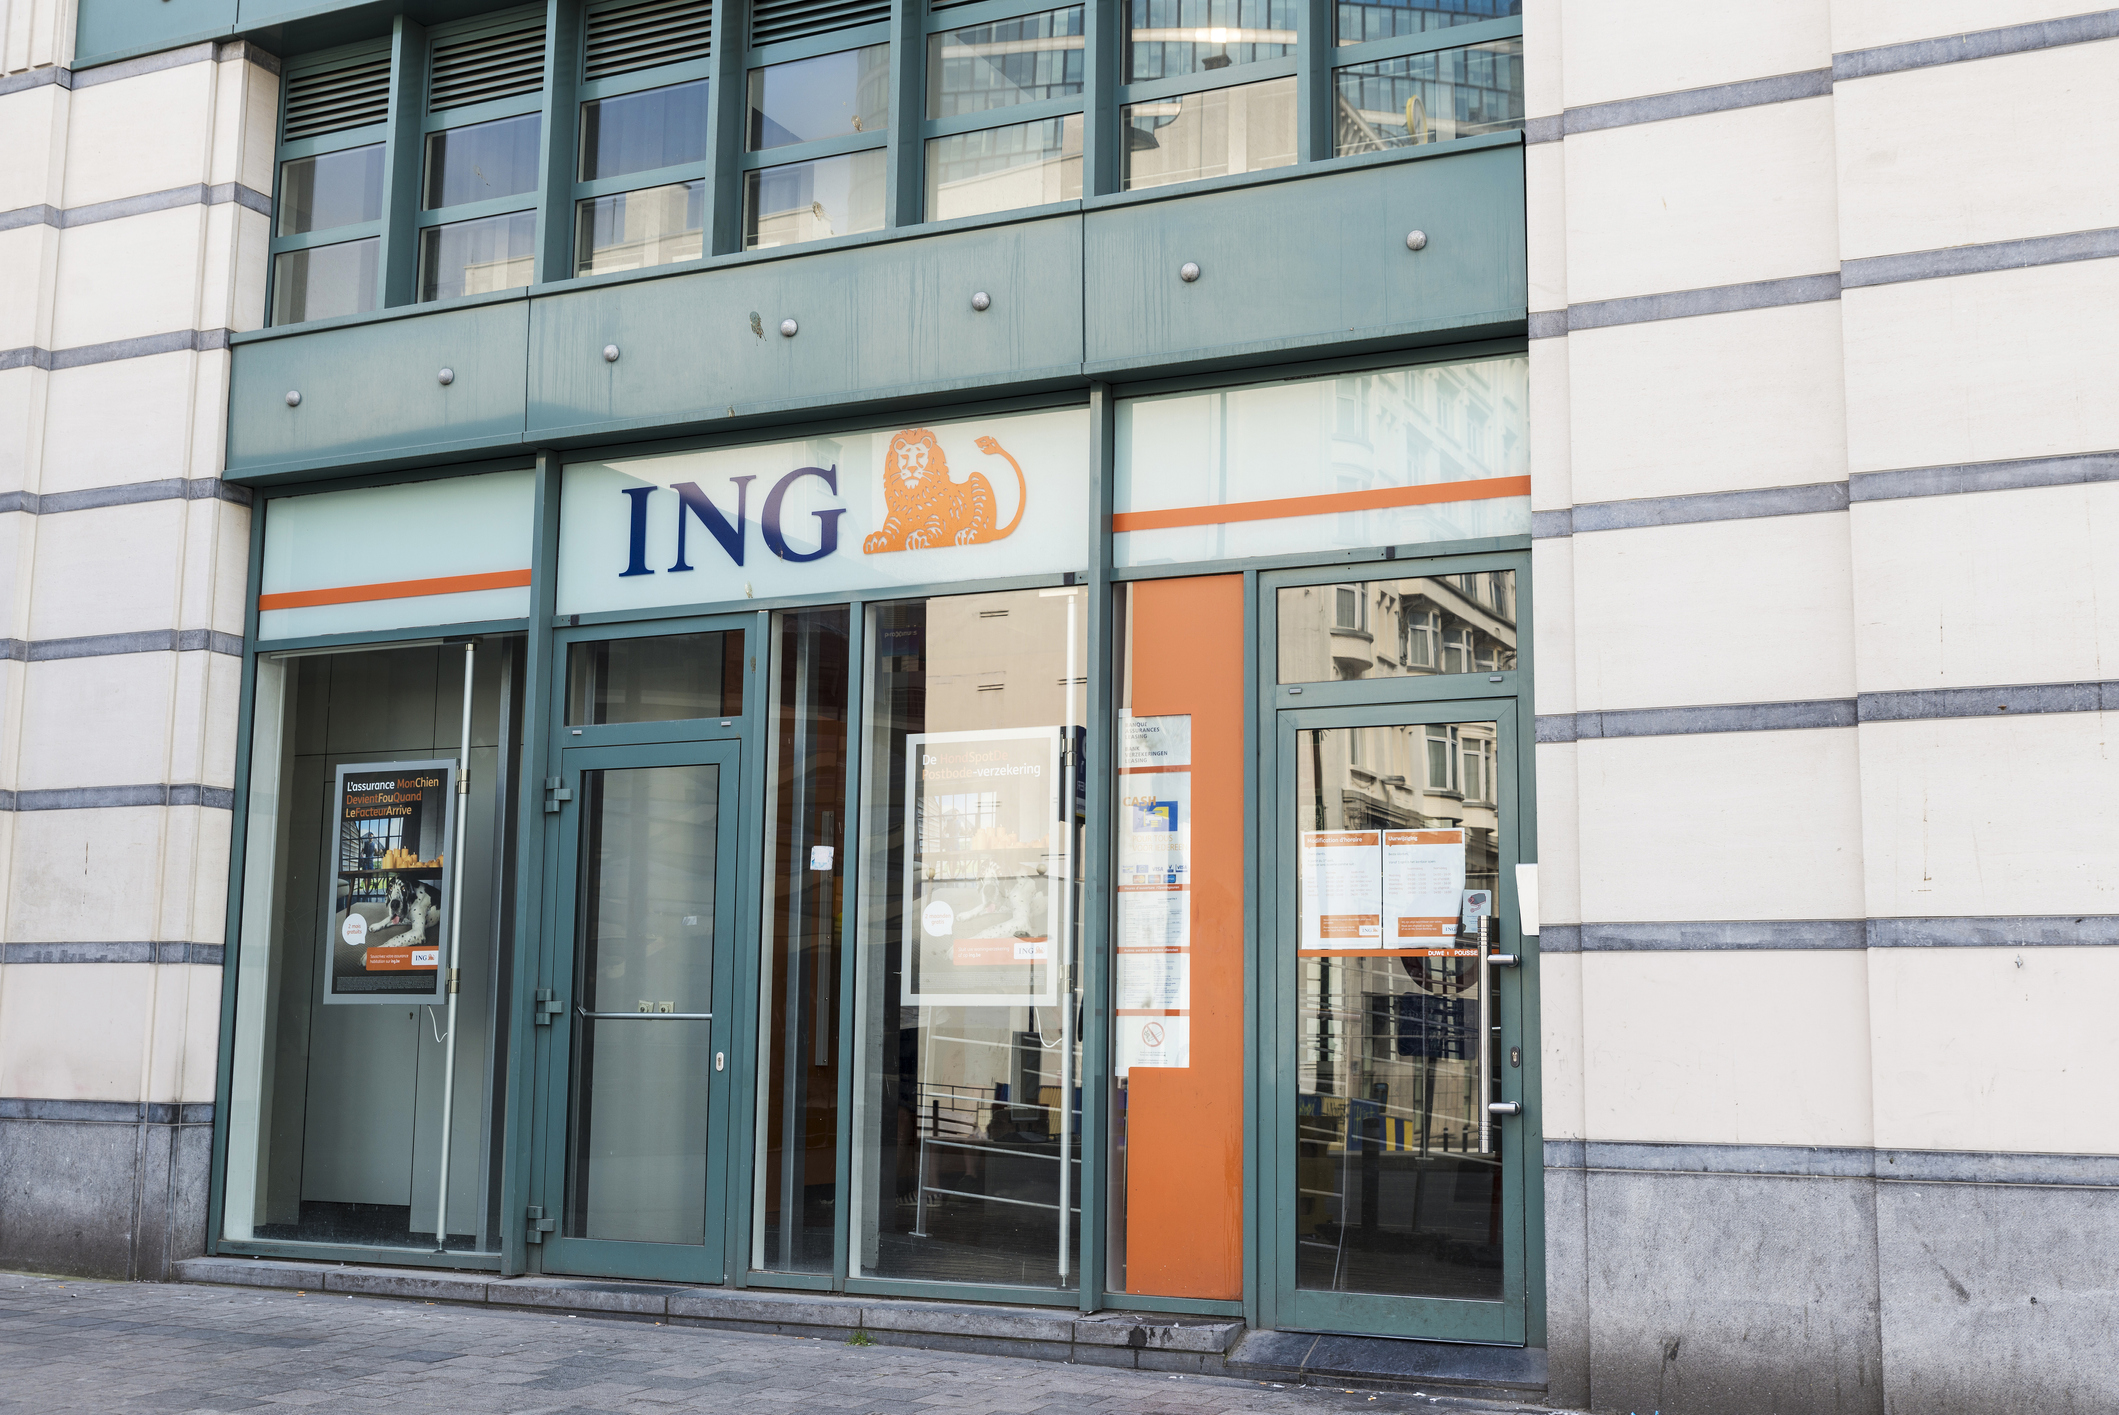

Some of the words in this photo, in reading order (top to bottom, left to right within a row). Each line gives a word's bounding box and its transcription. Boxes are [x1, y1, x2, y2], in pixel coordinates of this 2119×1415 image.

[619, 464, 847, 577] ING
[922, 754, 937, 766] De
[940, 749, 1009, 765] HondSpotDe
[922, 762, 1041, 780] Postbode-verzekering
[347, 780, 395, 792] L'assurance
[397, 776, 439, 789] MonChien
[346, 790, 422, 805] DevientFouQuand
[1123, 795, 1157, 807] CASH
[345, 804, 412, 818] LeFacteurArrive
[1133, 835, 1152, 843] POUR
[1154, 834, 1173, 842] TOUS
